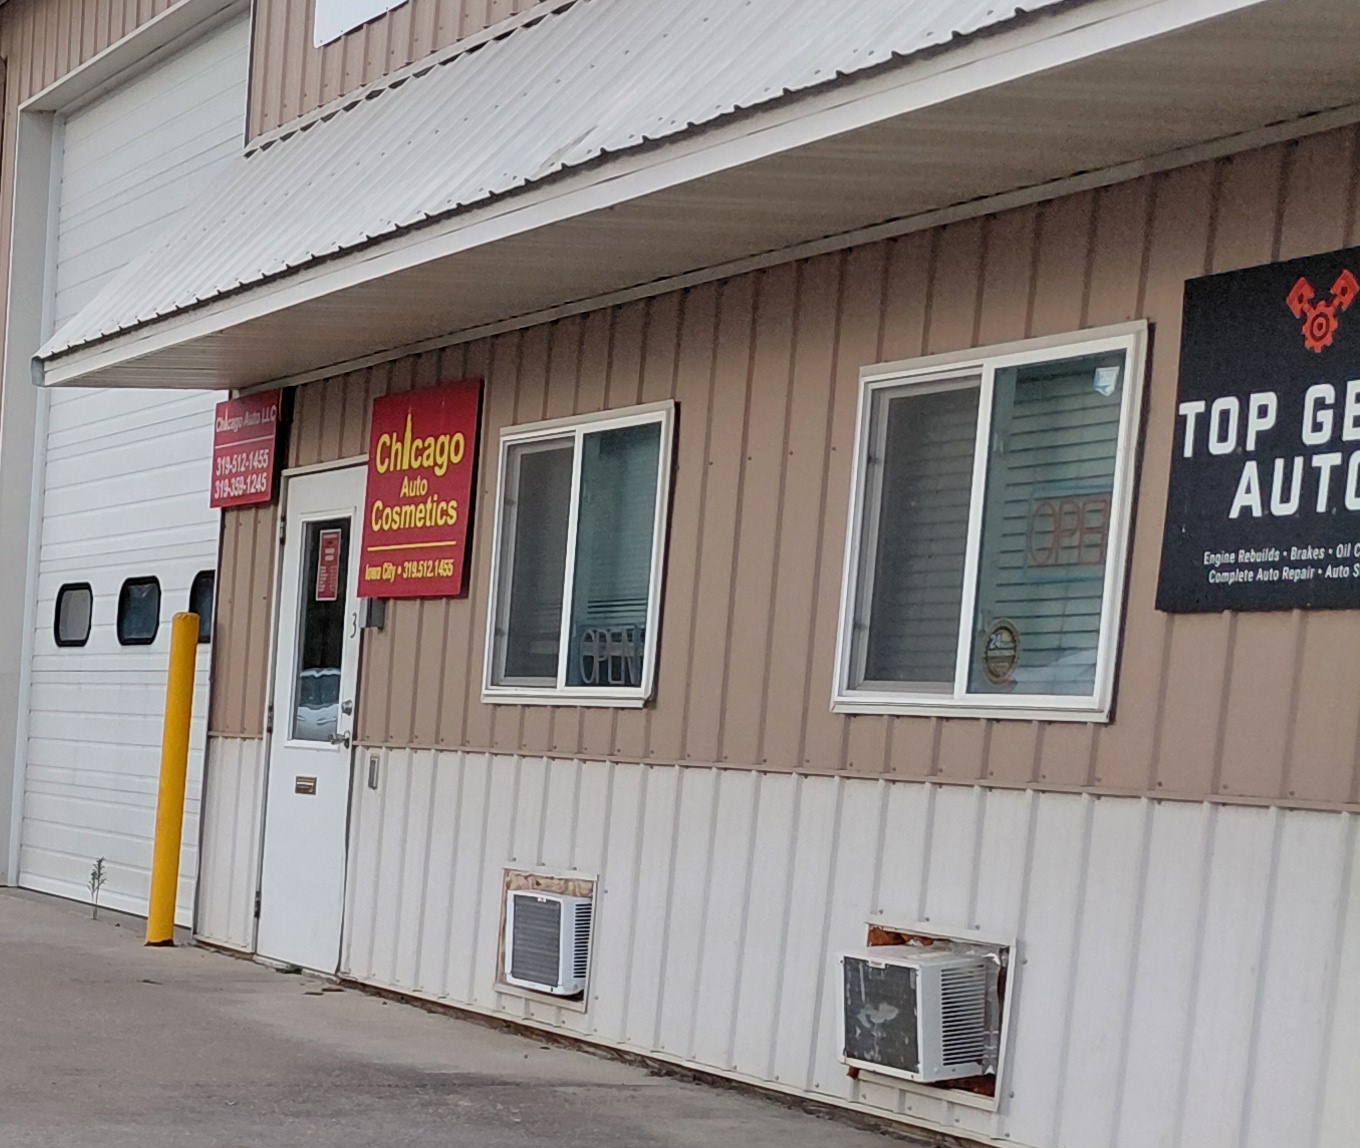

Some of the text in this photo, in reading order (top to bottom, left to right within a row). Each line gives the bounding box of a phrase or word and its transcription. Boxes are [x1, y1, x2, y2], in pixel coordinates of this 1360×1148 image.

[261, 405, 277, 423] LLC
[1179, 391, 1278, 458] TOP
[376, 413, 465, 476] Chicago
[216, 449, 269, 476] 319-512-1455
[400, 475, 428, 498] Auto
[372, 494, 458, 531] Cosmetics
[1204, 551, 1235, 567] Engine
[1238, 547, 1280, 563] Rebuilds
[1290, 544, 1325, 560] Brakes
[1336, 543, 1351, 558] Oil
[1208, 568, 1253, 585] Complete
[1255, 567, 1279, 581] Auto
[1282, 565, 1315, 582] Repair
[1325, 564, 1350, 578] Auto
[349, 611, 357, 639] 3
